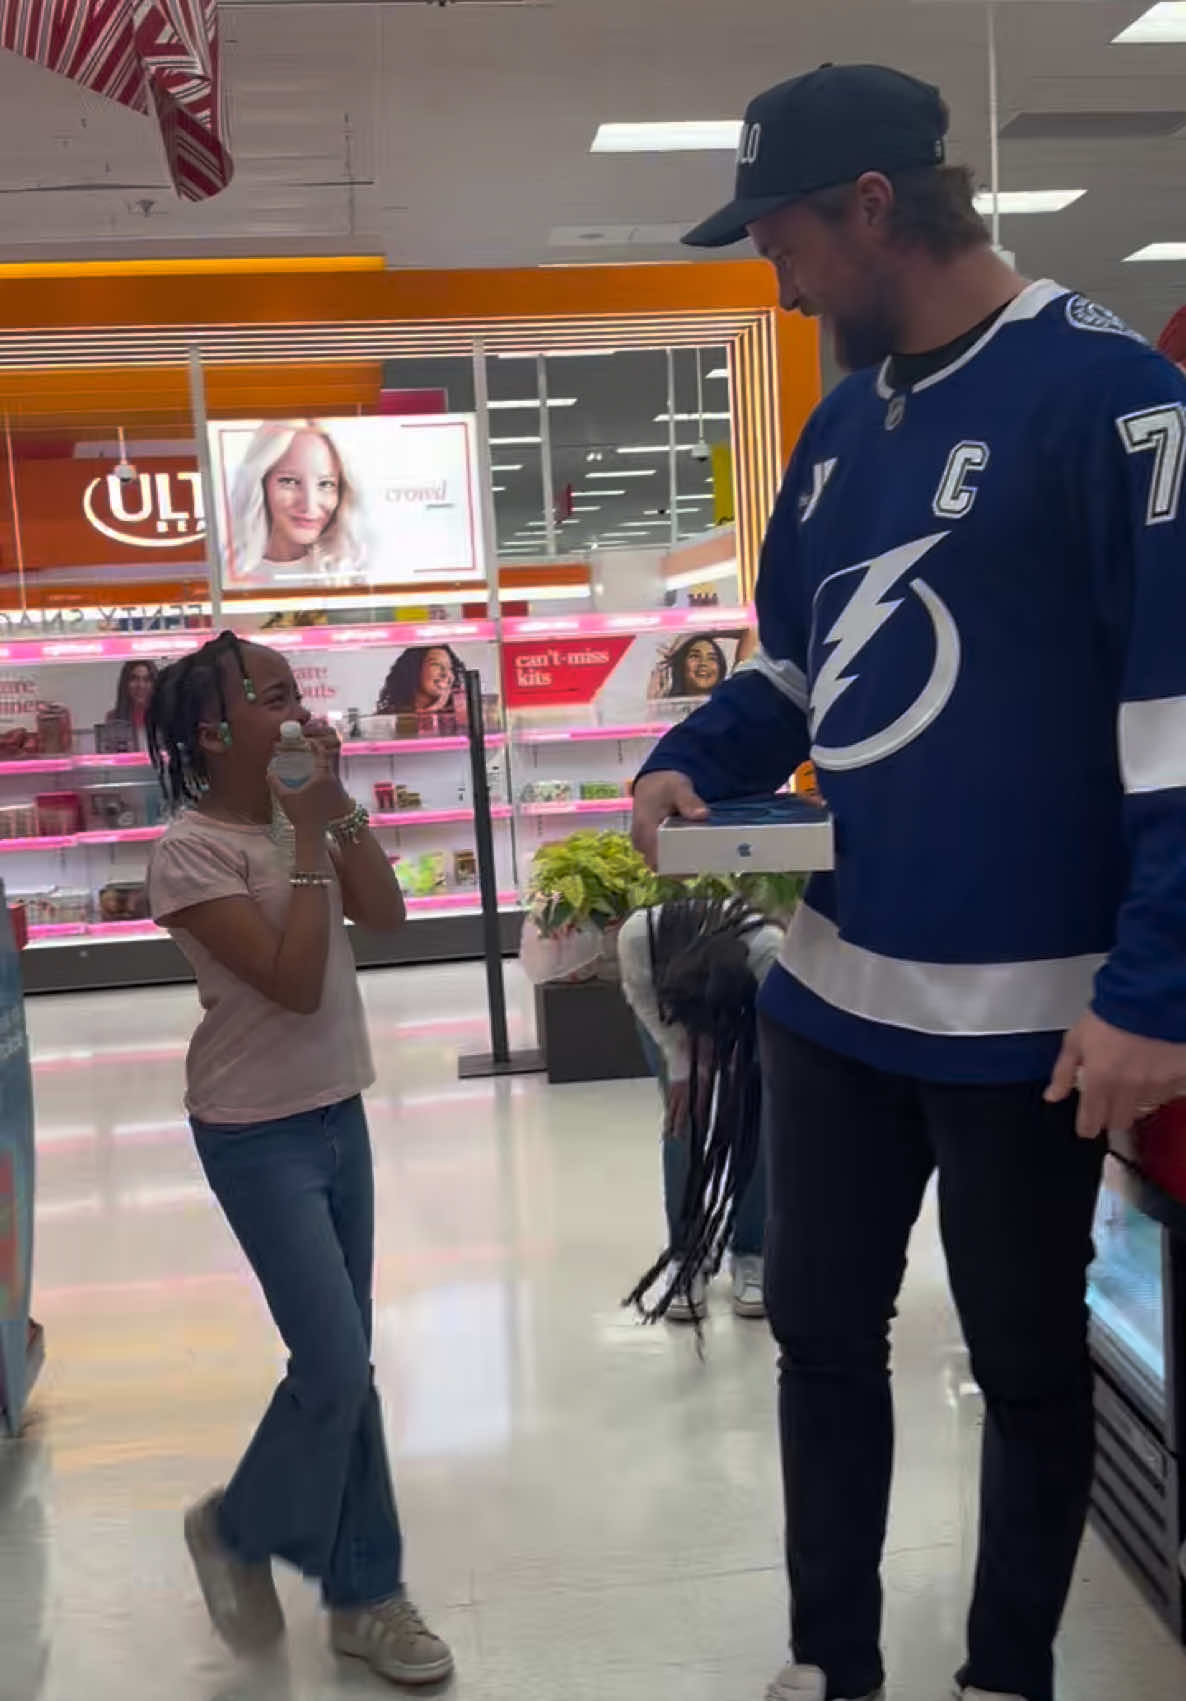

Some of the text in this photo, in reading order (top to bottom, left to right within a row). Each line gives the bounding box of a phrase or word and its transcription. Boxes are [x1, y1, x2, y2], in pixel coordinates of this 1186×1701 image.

[932, 441, 989, 518] C
[1116, 402, 1186, 526] 7
[385, 480, 448, 502] crowd
[516, 669, 552, 688] kits
